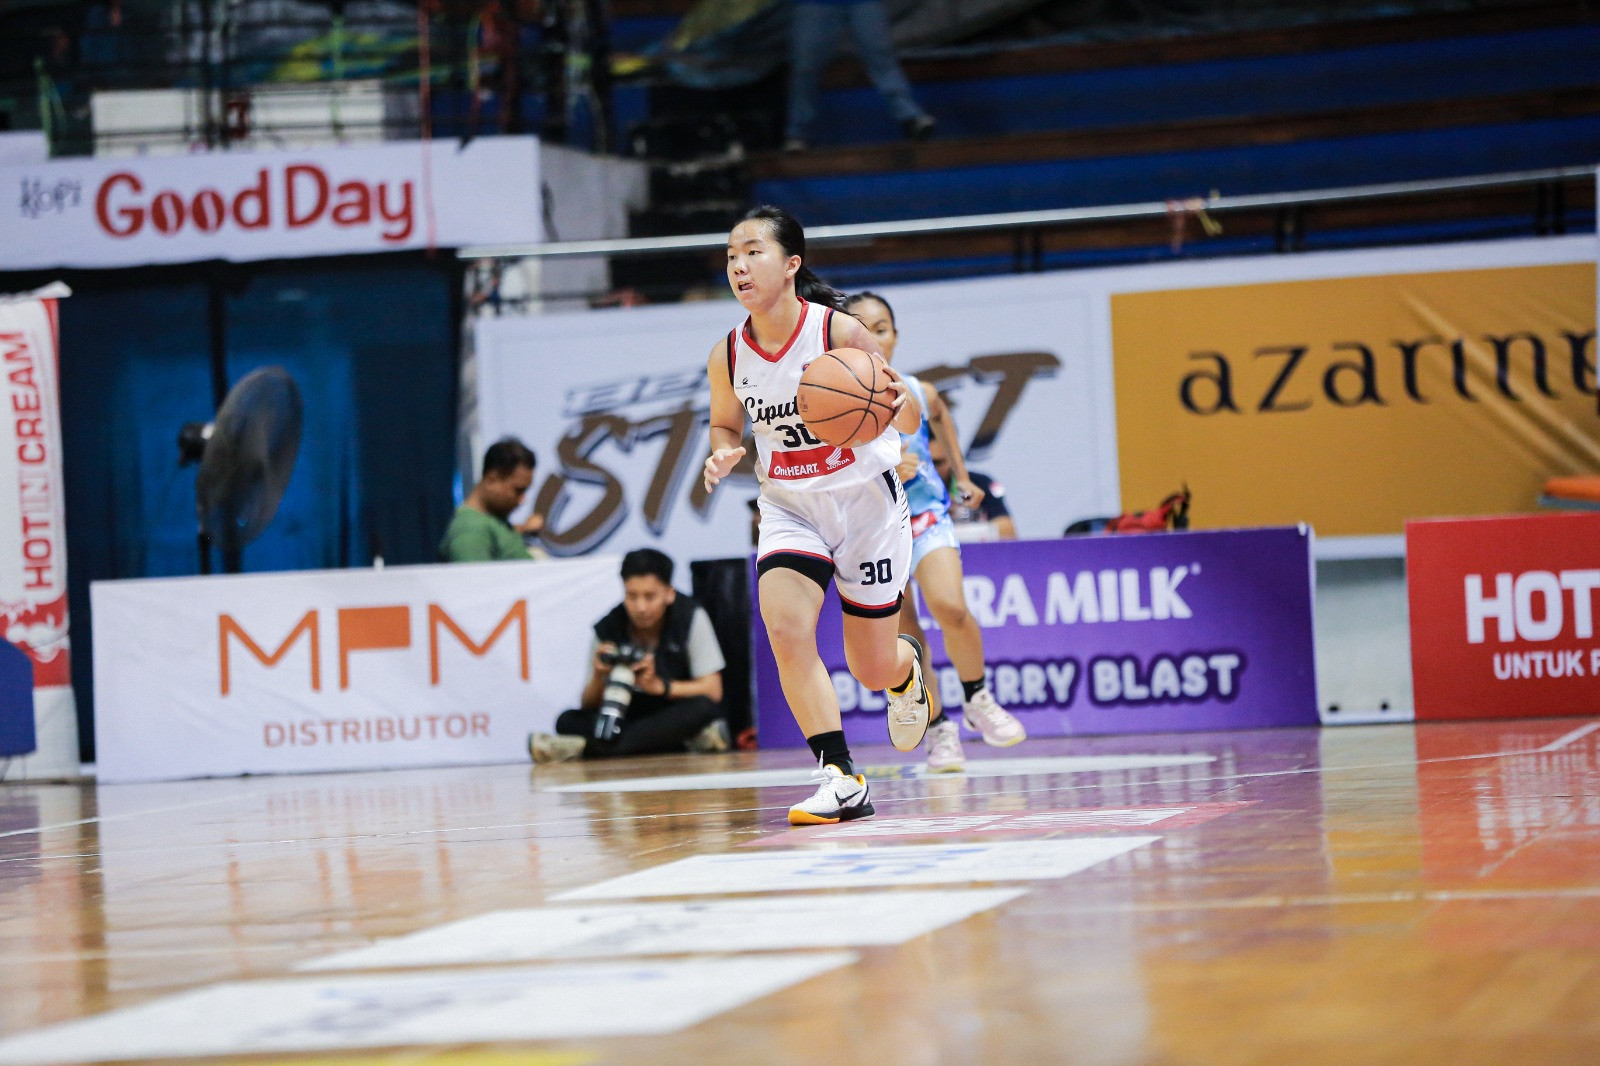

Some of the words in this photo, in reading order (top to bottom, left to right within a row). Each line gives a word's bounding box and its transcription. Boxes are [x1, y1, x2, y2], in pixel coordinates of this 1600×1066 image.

[96, 169, 269, 238] Good
[285, 164, 413, 243] Day
[0, 331, 46, 464] CREAM
[23, 516, 53, 590] HOT
[859, 558, 893, 586] 30
[1464, 568, 1600, 644] HOT
[219, 599, 529, 697] MPM
[1093, 654, 1240, 701] BLAST
[1493, 650, 1585, 680] UNTUK
[263, 712, 491, 748] DISTRIBUTOR
